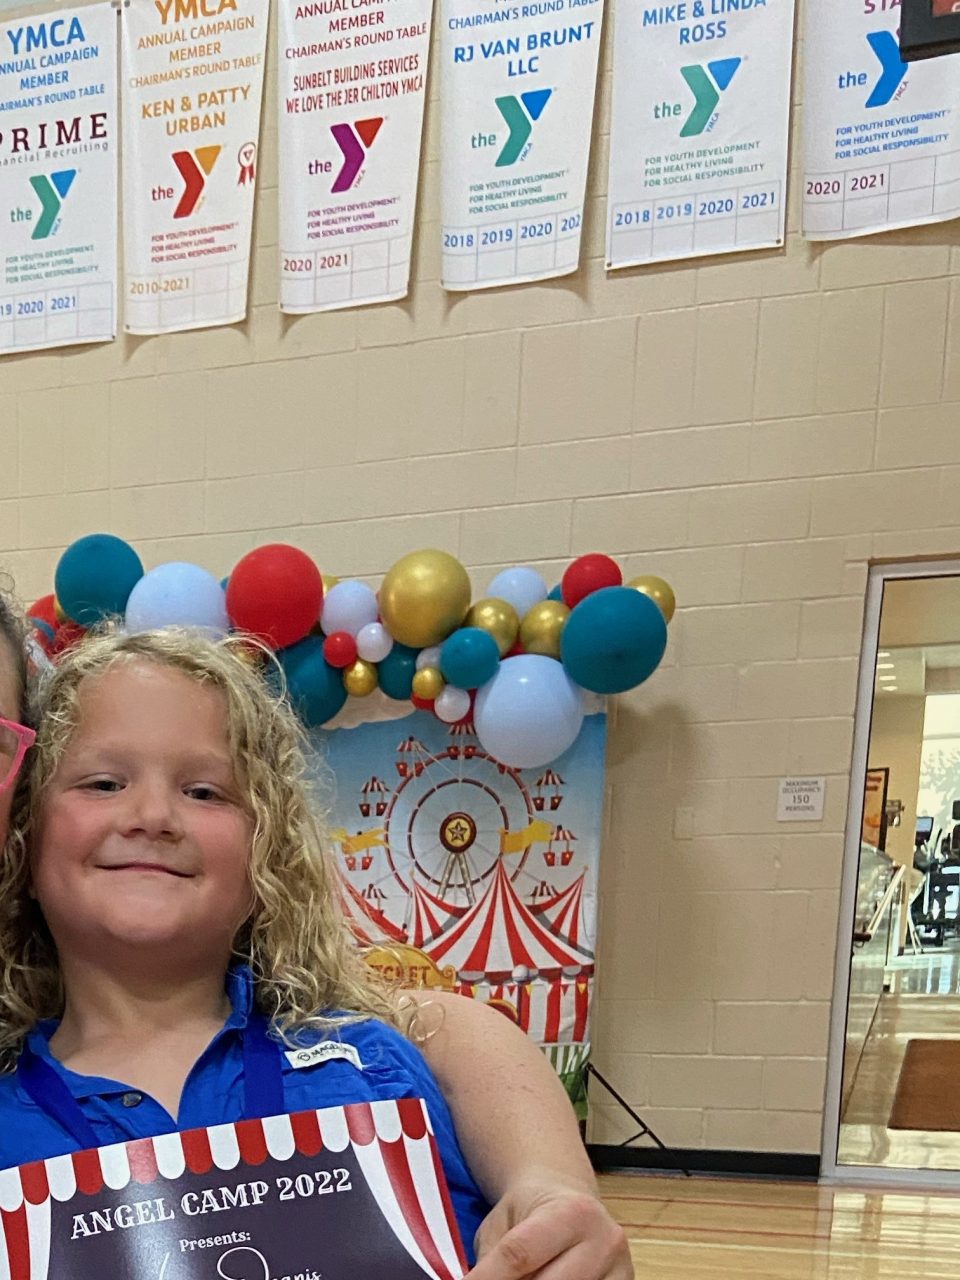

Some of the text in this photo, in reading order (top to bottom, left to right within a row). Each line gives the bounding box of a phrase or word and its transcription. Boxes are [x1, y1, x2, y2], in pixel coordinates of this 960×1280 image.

[155, 0, 238, 25] YMCA
[295, 0, 348, 20] ANNUAL
[449, 1, 564, 30] CHAIRMAN'S ROUND
[643, 0, 766, 26] MIKE & LINDA
[138, 16, 255, 50] ANNUAL CAMPAIGN
[328, 11, 384, 33] MEMBER
[680, 21, 727, 45] ROSS
[7, 16, 85, 55] YMCA
[285, 23, 427, 60] CHAIRMAN'S ROUND TABLE
[454, 22, 594, 63] RJ VAN BRUNT
[40, 46, 99, 68] CAMPAIGN
[169, 42, 221, 63] MEMBER
[129, 53, 261, 88] CHAIRMAN'S ROUND TABLE
[293, 54, 418, 92] SUNBELT BUILDING SERVICES
[508, 56, 539, 77] LLC
[20, 70, 69, 90] MEMBER
[838, 72, 867, 89] the
[45, 90, 76, 105] ROUND
[79, 84, 105, 100] TABLE
[142, 85, 251, 120] KEN & PATTY
[286, 75, 423, 114] WE LOVE THE JER CHILTON YMCA
[654, 102, 682, 119] the
[166, 112, 225, 136] URBAN
[836, 110, 946, 136] FOR YOUTH DEVELOPMENT
[472, 133, 496, 149] the
[835, 134, 949, 159] FOR SOCIAL RESPONSIBILITY
[836, 126, 919, 147] FOR HEALTHY LIVING
[45, 142, 109, 162] Recruiting
[645, 141, 760, 165] FOR YOUTH DEVELOPMENT
[308, 160, 332, 175] the
[644, 164, 765, 187] FOR SOCIAL RESPONSIBILITY
[645, 156, 733, 176] FOR HEALTHY LIVING
[152, 185, 173, 201] the
[807, 173, 885, 195] 2020 2021
[10, 208, 32, 223] the
[615, 191, 775, 225] 2018 2019 2020 2021
[444, 222, 552, 247] 2018 2019 2020
[284, 254, 347, 271] 2020 2021
[18, 296, 76, 315] 2020 2021
[793, 795, 810, 804] 150
[70, 1168, 352, 1240] ANGEL CAMP 2022
[179, 1231, 251, 1252] Presents:
